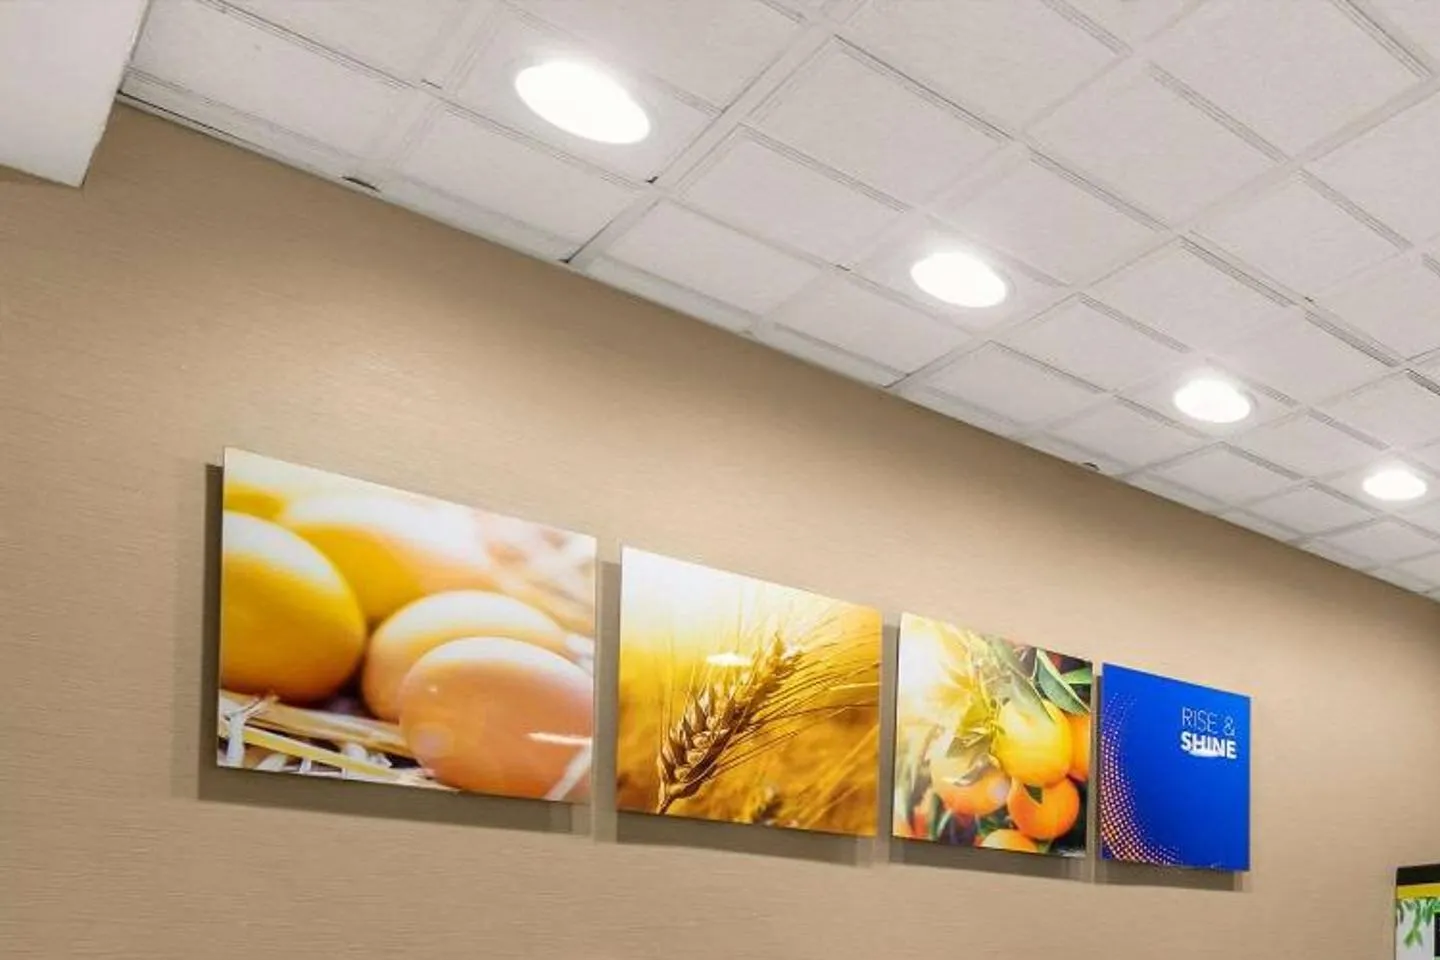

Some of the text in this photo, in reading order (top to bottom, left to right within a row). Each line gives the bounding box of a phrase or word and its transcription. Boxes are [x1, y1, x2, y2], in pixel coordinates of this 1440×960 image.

[1182, 706, 1236, 737] RISE &
[1180, 731, 1238, 760] SHINE
